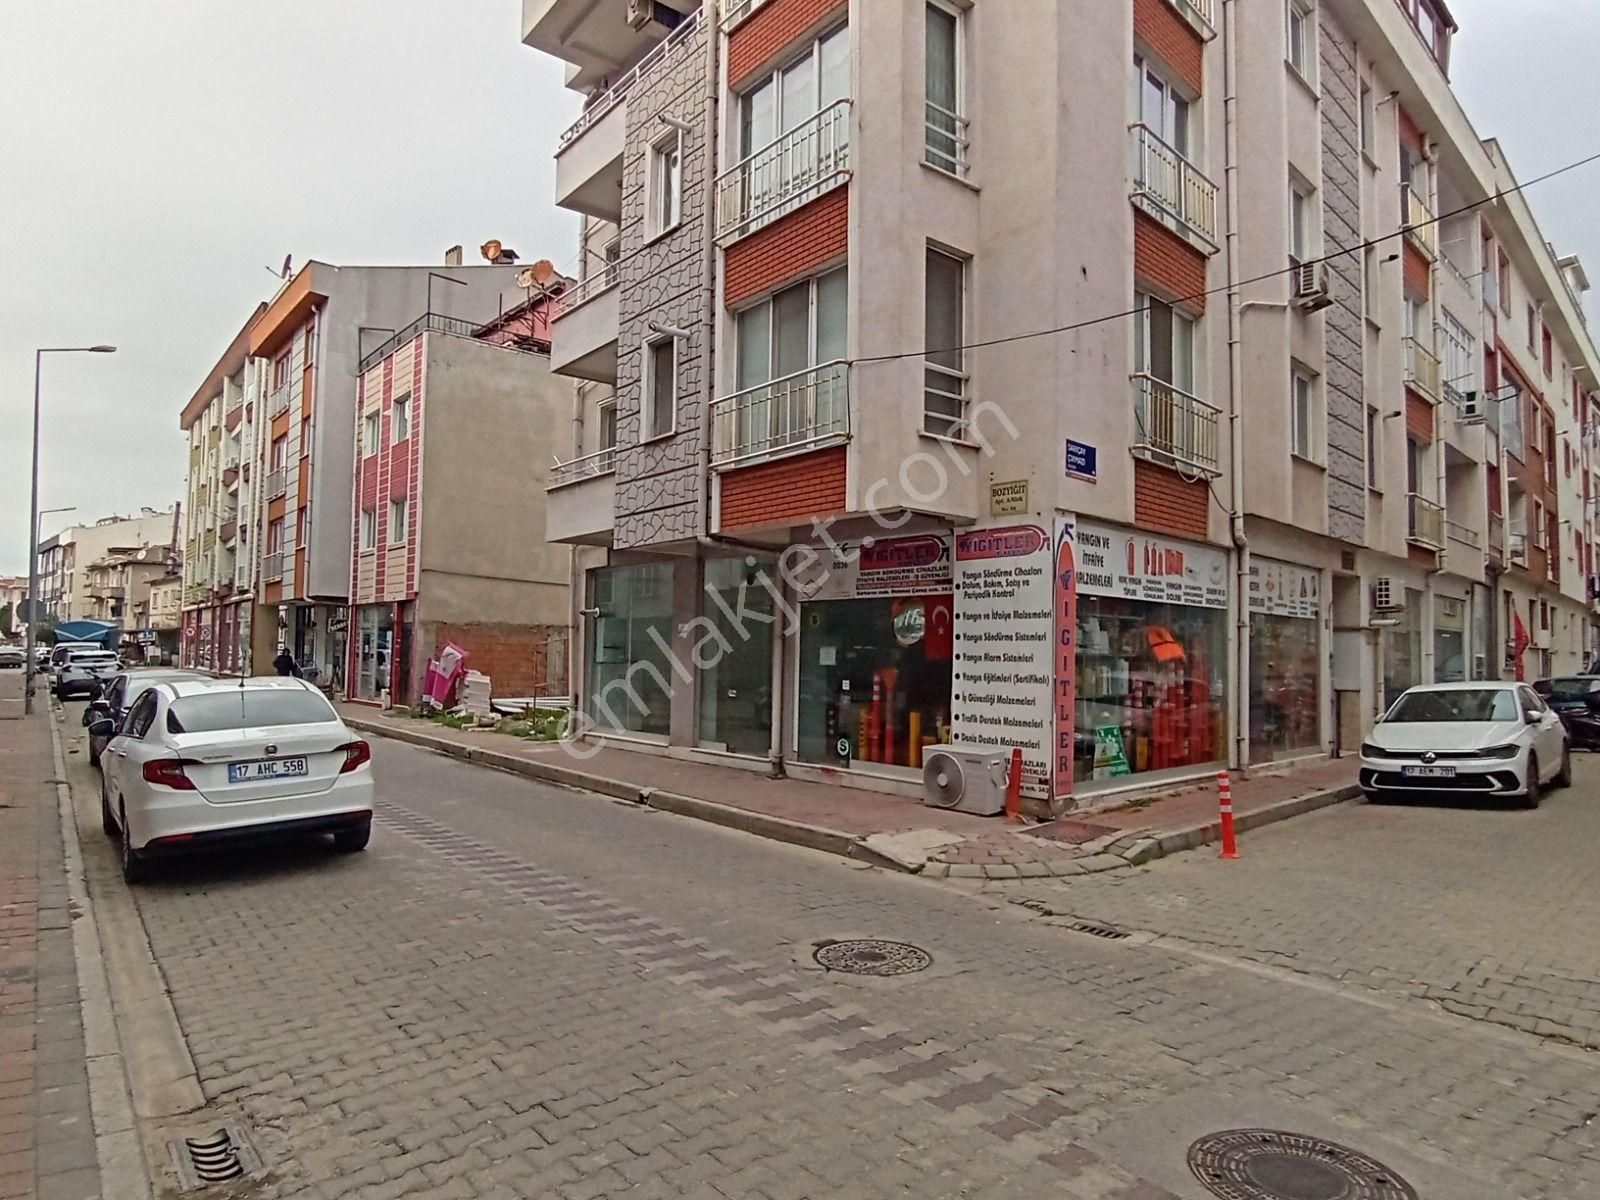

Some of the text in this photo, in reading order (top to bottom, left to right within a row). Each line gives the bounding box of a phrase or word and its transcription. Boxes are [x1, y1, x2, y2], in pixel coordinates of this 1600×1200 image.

[1076, 531, 1110, 550] YANGIN VE
[962, 566, 1042, 581] Yangın Söndürme Cihazları
[992, 588, 1015, 599] Kontrol
[962, 611, 982, 622] Yangın
[1013, 609, 1052, 620] Malzemeleri
[962, 631, 1047, 643] Yangın Söndürme Sistemleri
[962, 653, 1034, 664] Yangın Alarm Sistemleri
[962, 673, 982, 684] Yangın
[996, 695, 1036, 707] Malzemeleri
[962, 713, 978, 723] Trafik
[1003, 717, 1044, 729] Malzemeleri
[978, 733, 999, 744] Destek
[1000, 736, 1041, 750] Malzemeleri
[237, 760, 304, 776] 17 AHC 558
